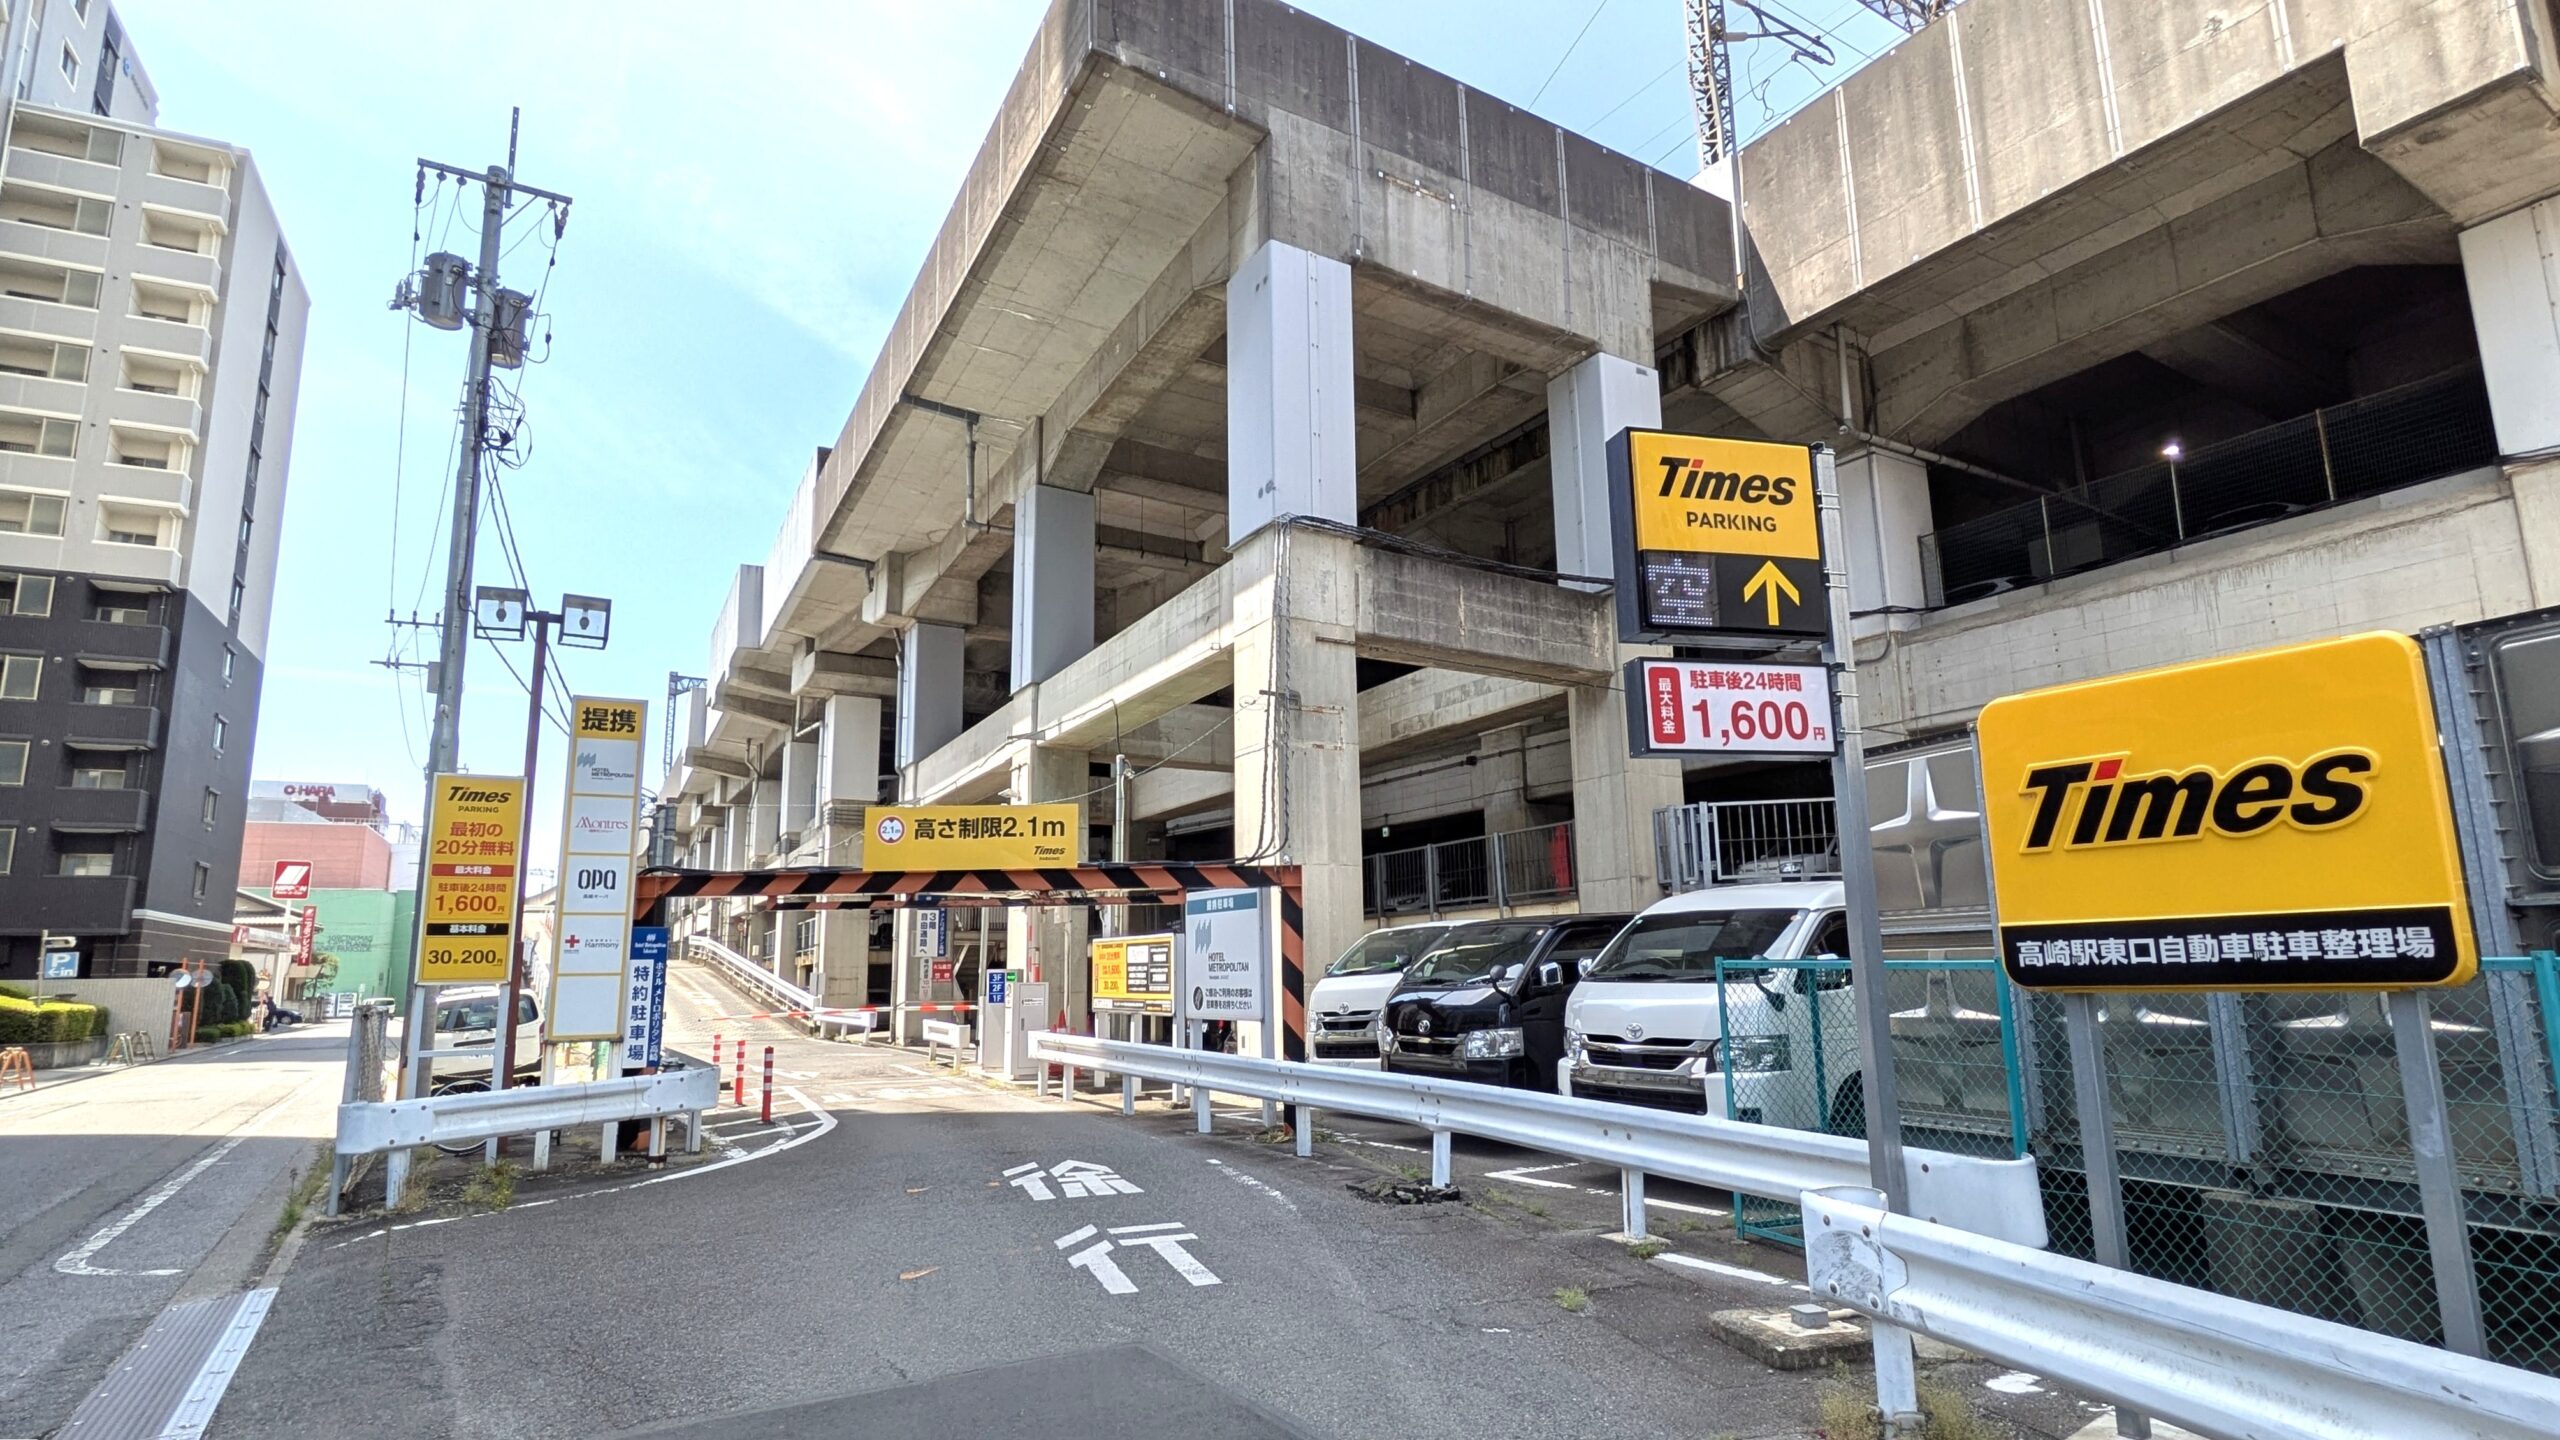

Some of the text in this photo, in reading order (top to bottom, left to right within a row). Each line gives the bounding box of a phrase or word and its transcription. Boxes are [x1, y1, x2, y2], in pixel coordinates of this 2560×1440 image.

[1658, 455, 1796, 505] Times
[1686, 511, 1777, 532] PARKING
[1647, 558, 1713, 626] 空
[1689, 670, 1802, 692] 駐車後24時間
[1658, 678, 1676, 734] 最大料金
[582, 706, 637, 733] 提携
[1691, 699, 1826, 746] 1,600円
[448, 786, 511, 803] Times
[2024, 753, 2374, 848] Times
[458, 805, 499, 813] PARKING
[450, 821, 503, 837] 最初の
[575, 816, 628, 829] Montres
[914, 816, 1066, 840] 高さ制限2.1m
[435, 840, 514, 856] 20分無料
[1034, 845, 1066, 855] Times
[454, 866, 492, 874] 最大料金
[578, 869, 616, 890] OPA
[438, 883, 506, 893] 駐車後24時間
[449, 924, 487, 934] 基本料金
[2016, 926, 2436, 968] 高崎駅東口自動車駐車整理場
[51, 953, 72, 968] P
[1208, 952, 1226, 962] HOTEL
[60, 967, 74, 977] in
[654, 962, 664, 986] ホテル
[1208, 962, 1250, 972] METROPOLITAN
[992, 973, 1002, 982] 3F
[992, 984, 1002, 992] 2F
[992, 994, 1002, 1002] 1F
[628, 965, 650, 1061] 特約駐車場
